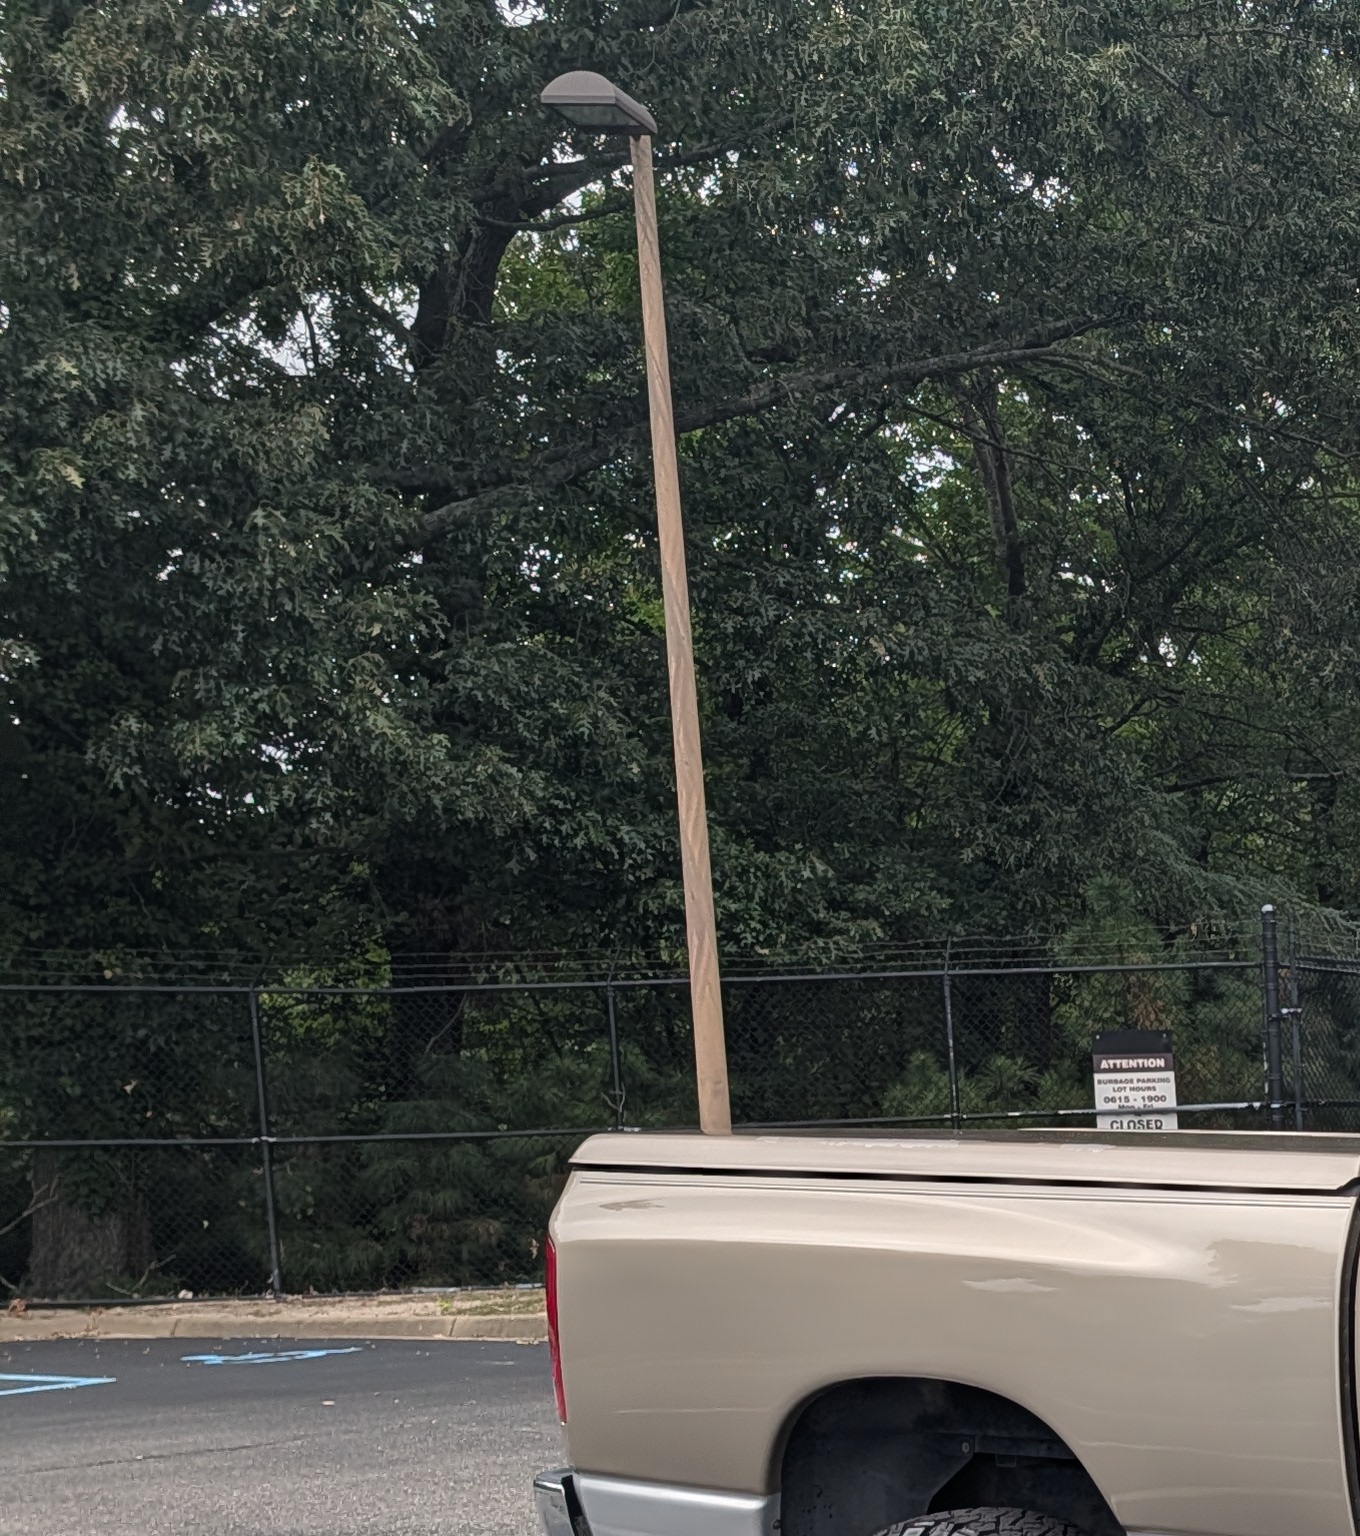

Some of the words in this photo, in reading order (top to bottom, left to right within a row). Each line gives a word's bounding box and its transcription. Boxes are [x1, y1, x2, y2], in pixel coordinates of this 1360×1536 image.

[1100, 1058, 1165, 1070] ATTENTION
[1103, 1096, 1130, 1104] 0615
[1141, 1095, 1167, 1103] 1900
[1110, 1119, 1163, 1130] CLOSED
